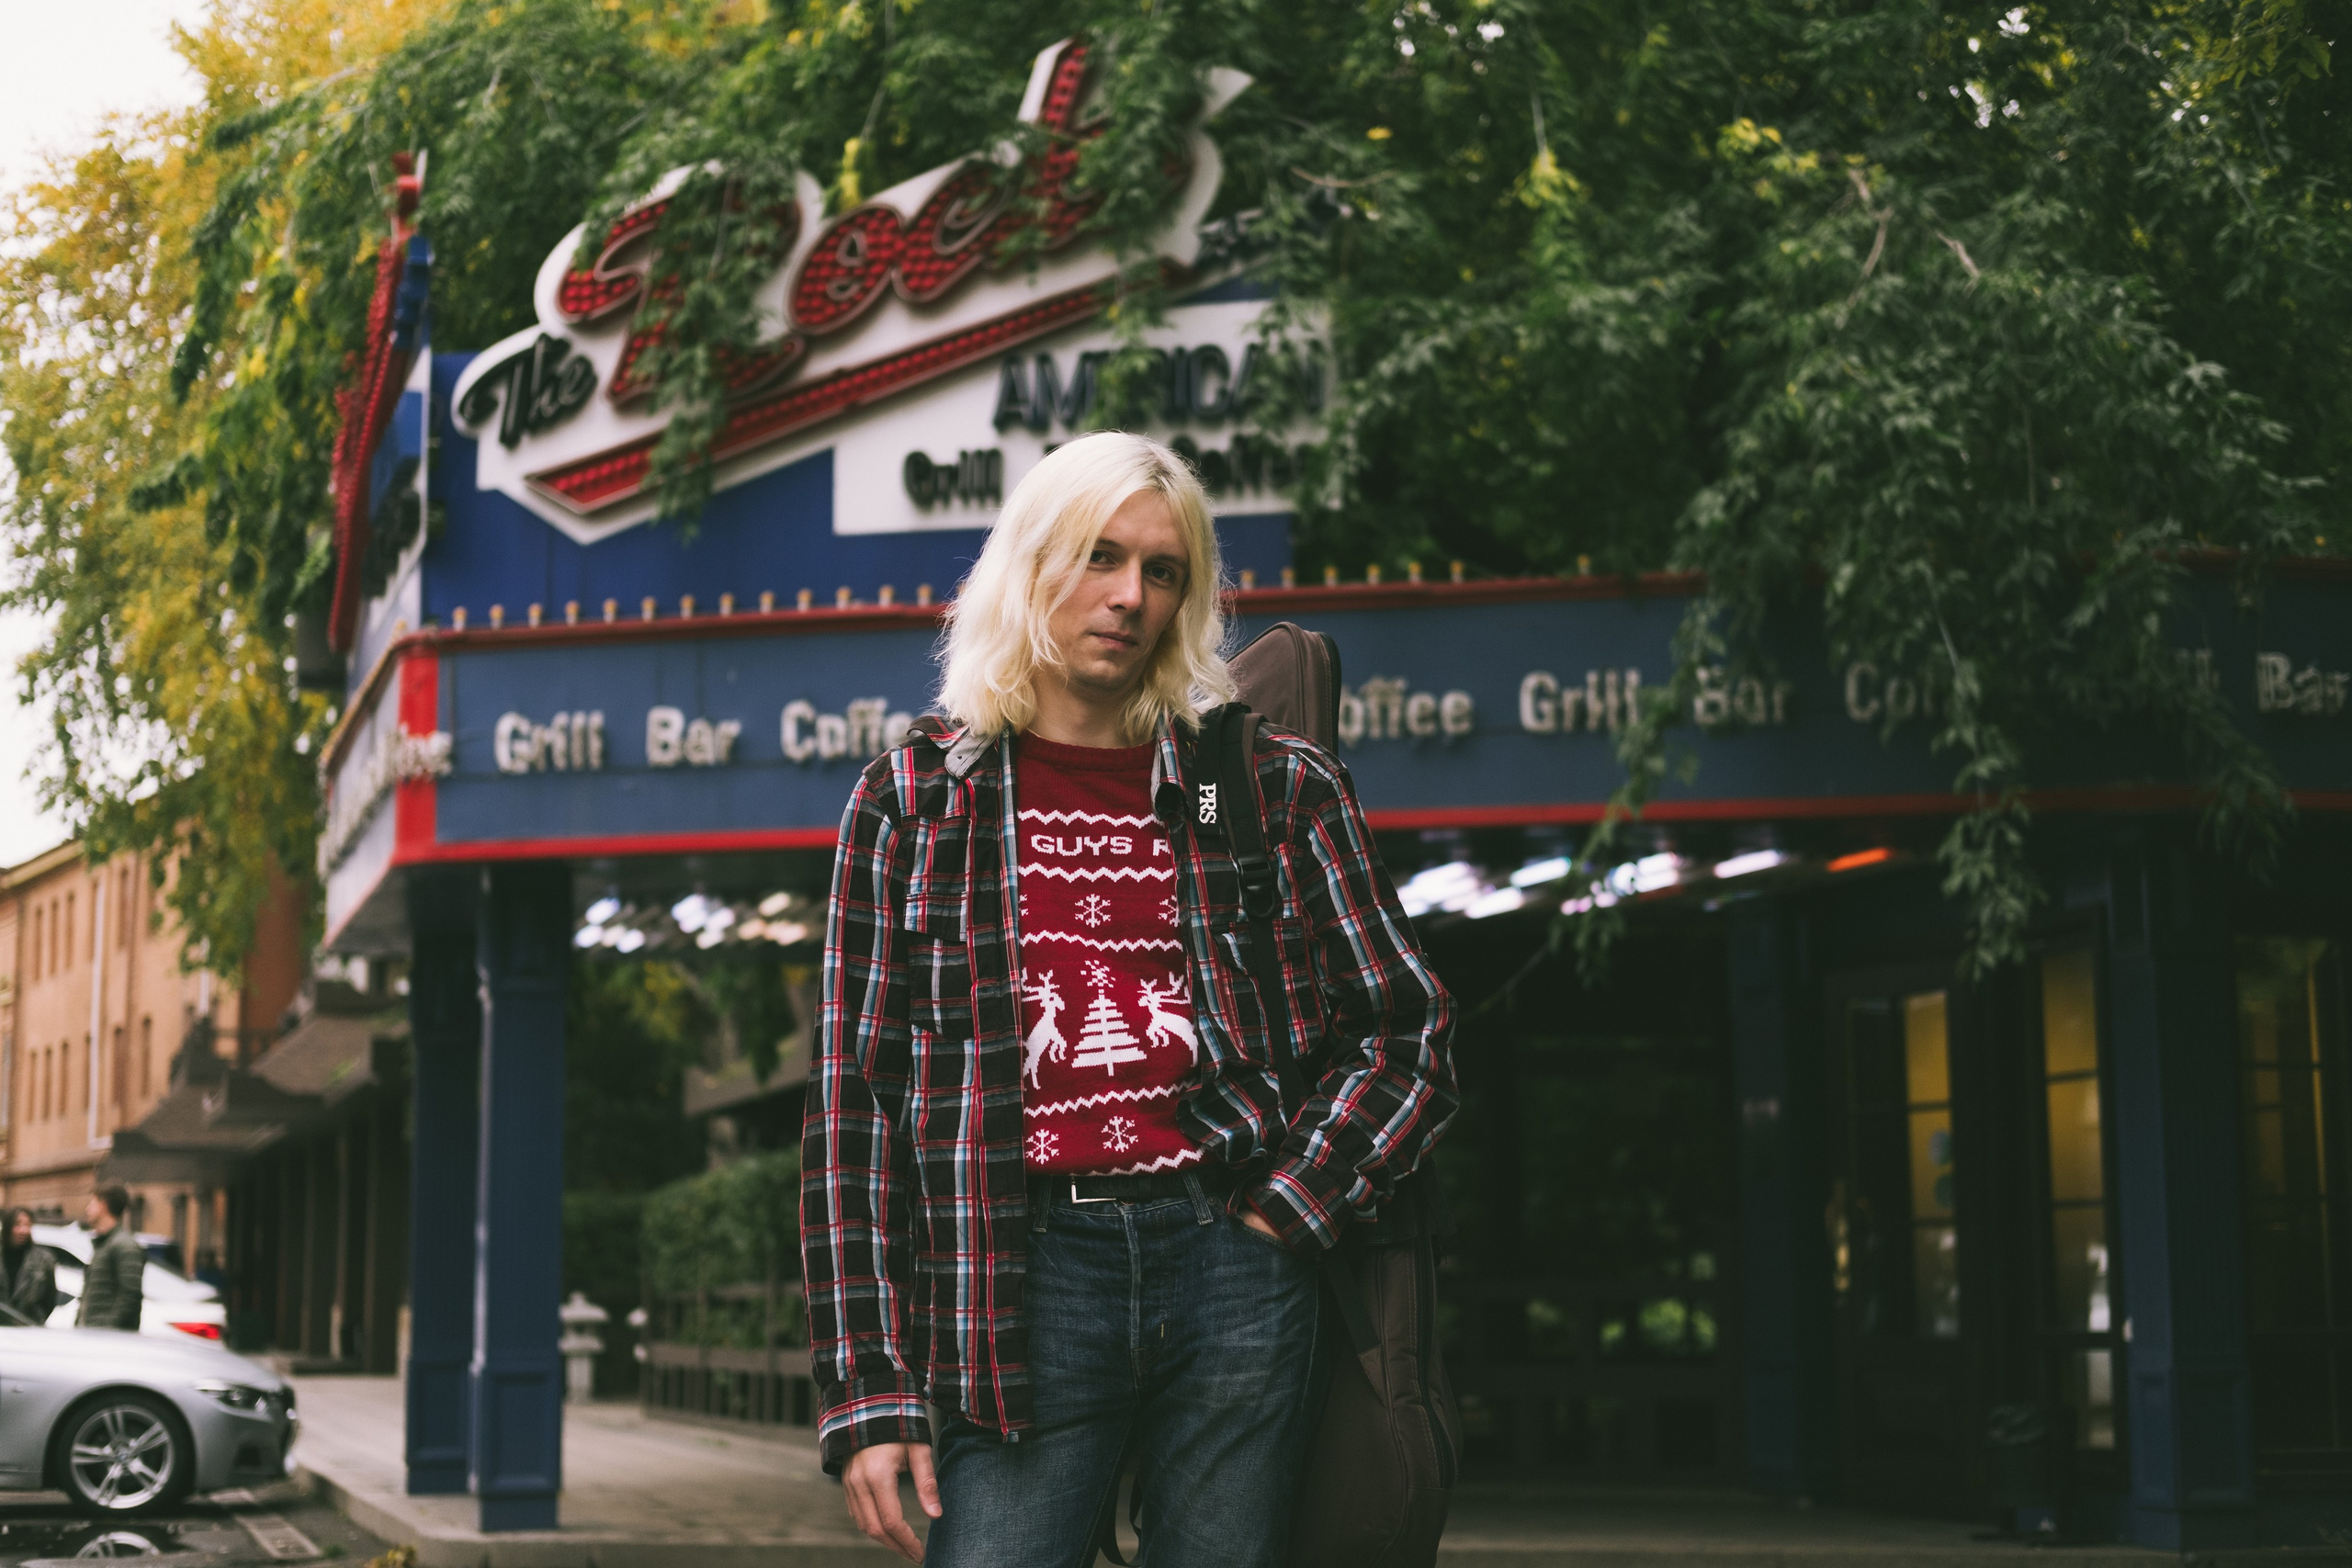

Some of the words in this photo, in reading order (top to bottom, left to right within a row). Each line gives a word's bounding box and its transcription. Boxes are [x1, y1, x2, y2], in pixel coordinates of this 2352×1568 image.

[458, 333, 599, 450] The
[493, 711, 605, 773] Grill
[645, 705, 742, 768] Bar
[781, 697, 942, 763] Coffe
[1339, 675, 1472, 740] offee
[1519, 668, 1640, 732] Grill
[2255, 651, 2350, 715] Bar
[1198, 783, 1217, 824] PRS
[1031, 834, 1133, 856] GUYS
